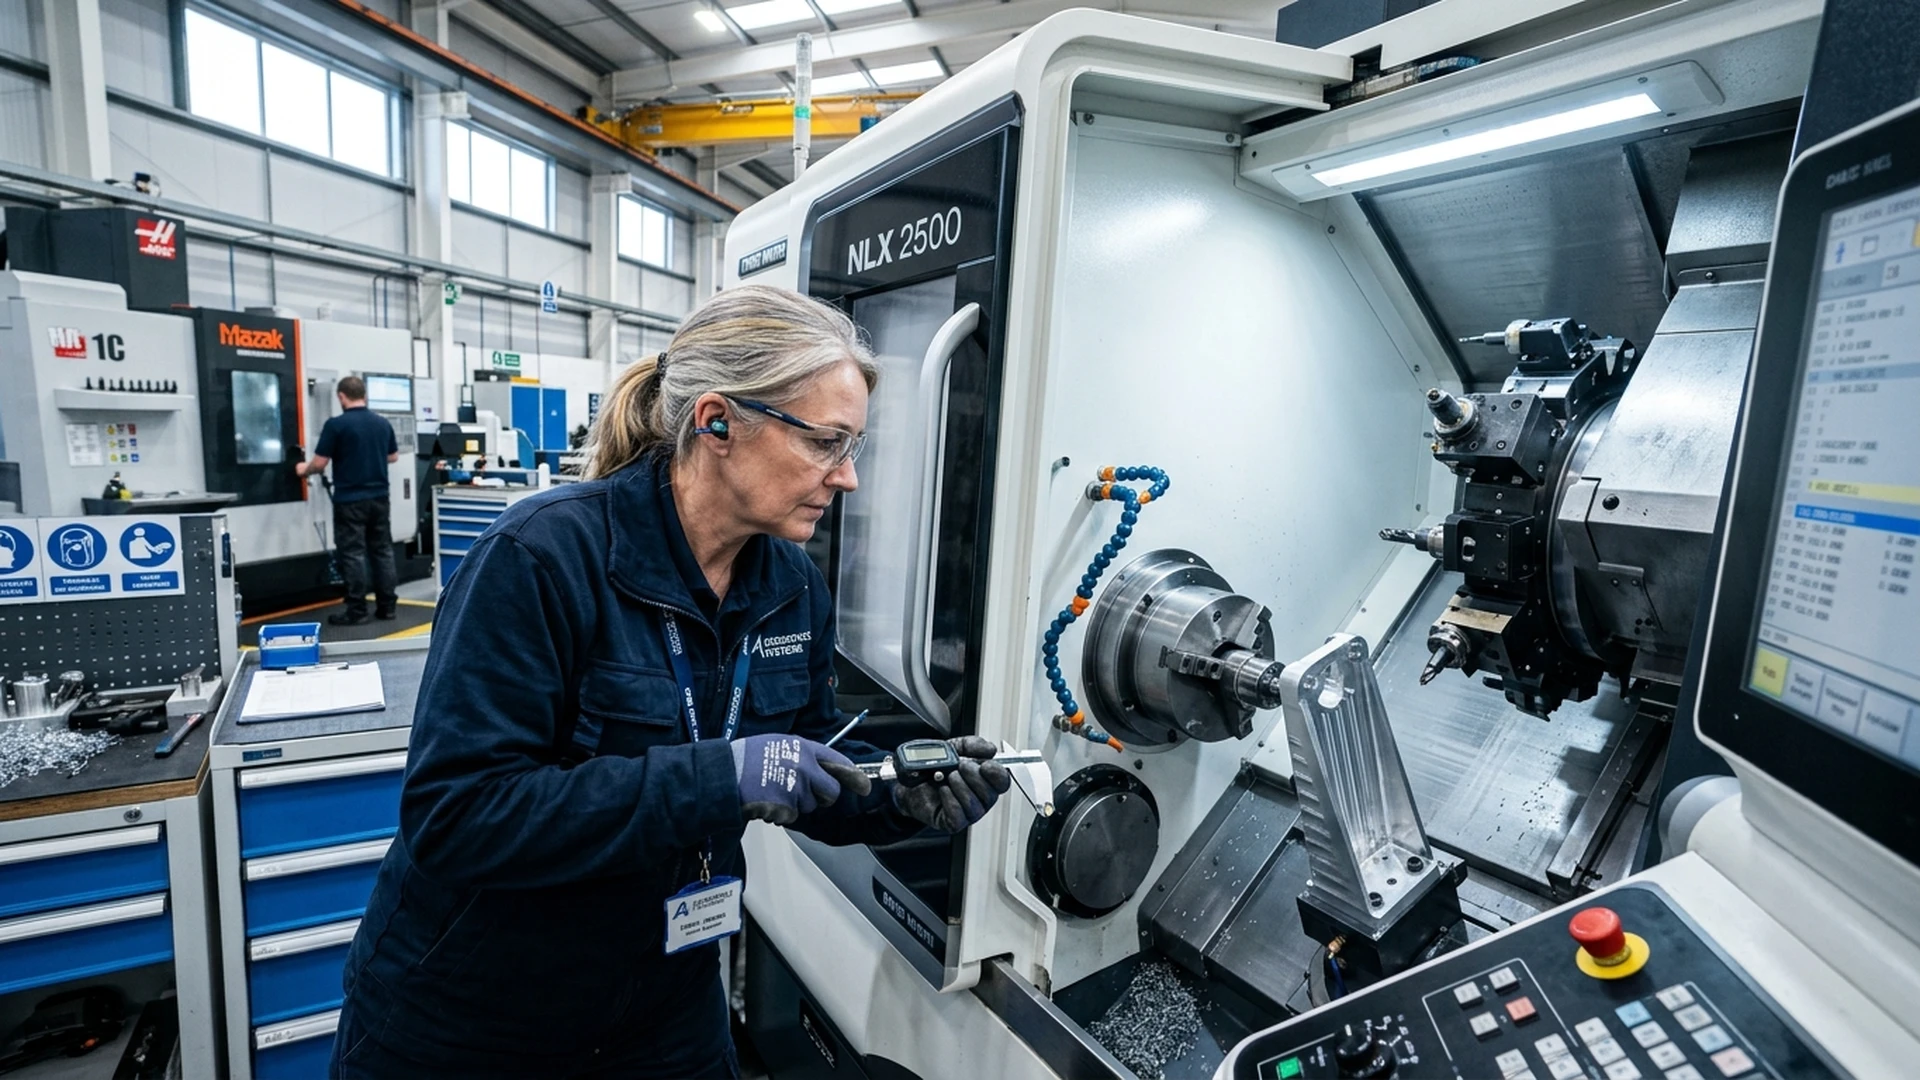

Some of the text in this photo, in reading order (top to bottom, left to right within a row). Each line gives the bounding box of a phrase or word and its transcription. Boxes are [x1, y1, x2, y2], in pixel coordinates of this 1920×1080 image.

[848, 207, 962, 275] NLX 2500
[91, 333, 125, 362] 1C
[219, 322, 285, 350] Mazak
